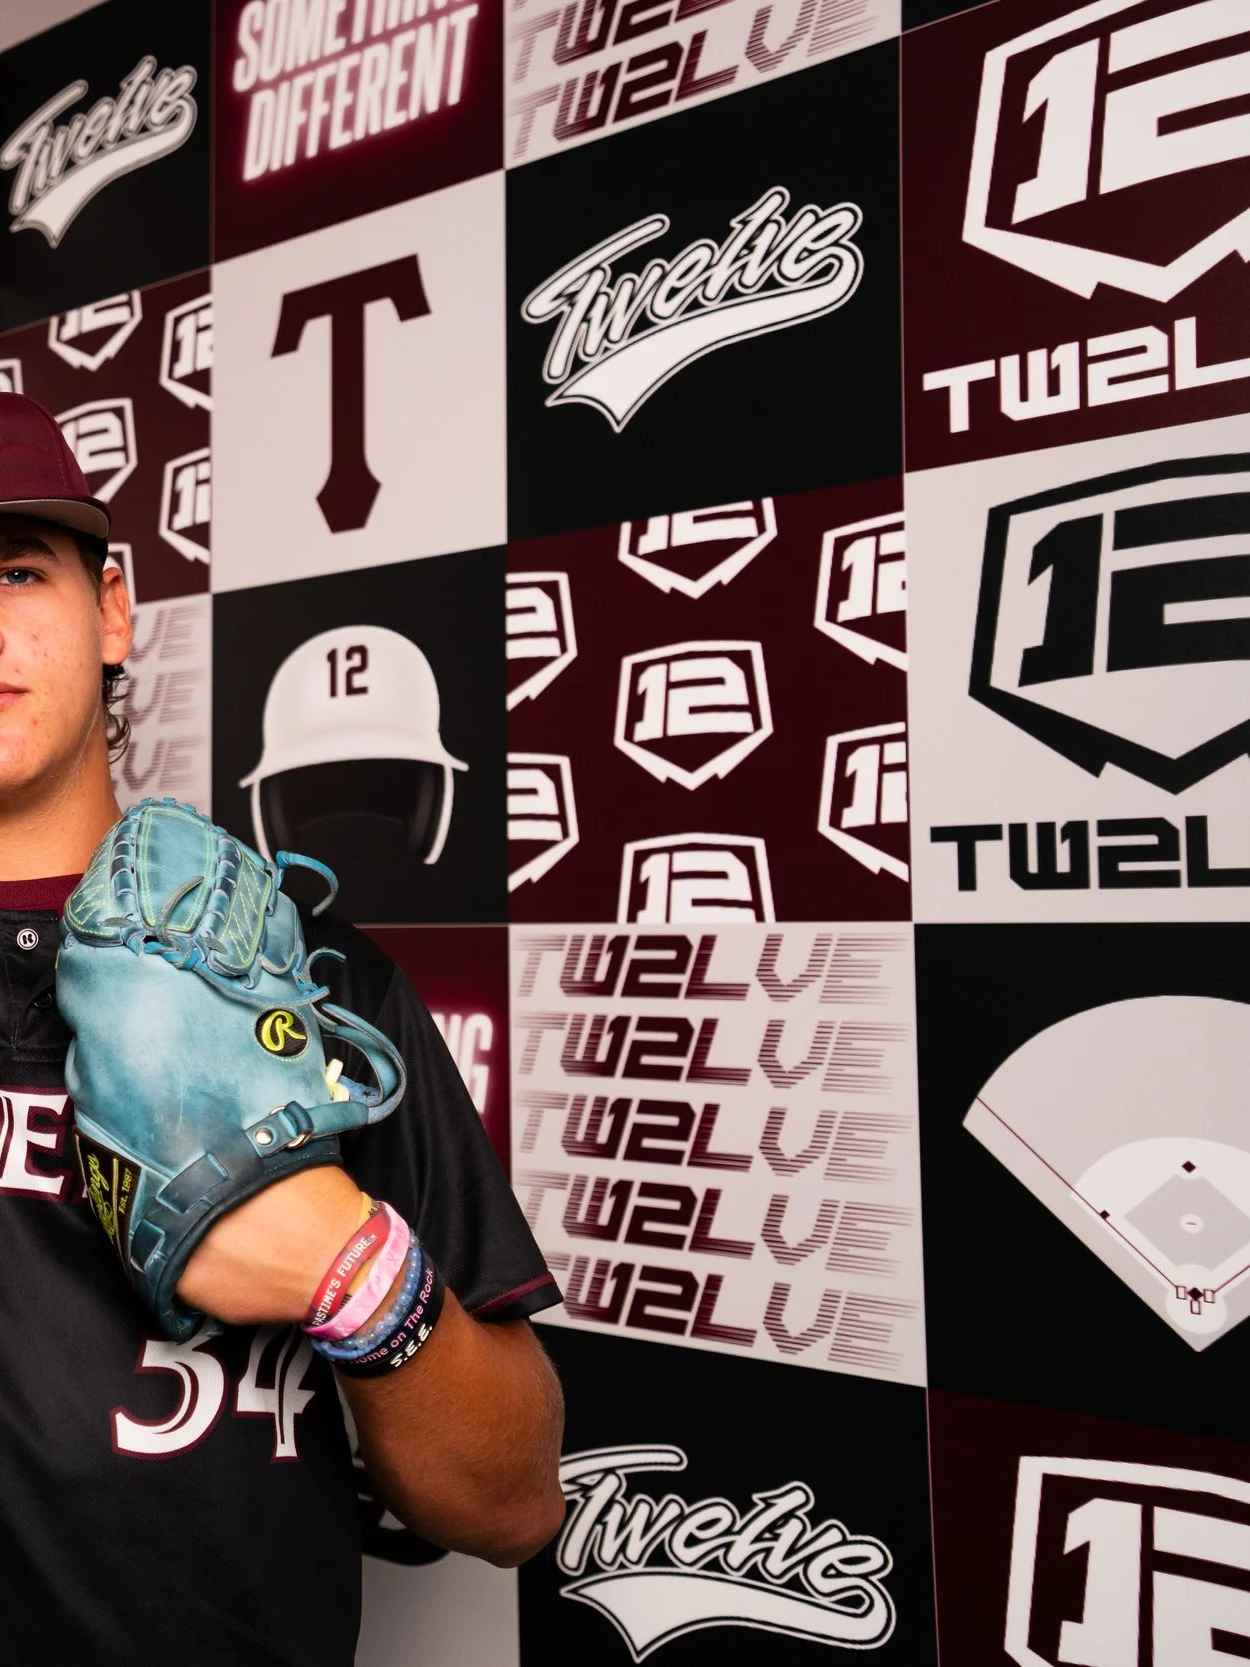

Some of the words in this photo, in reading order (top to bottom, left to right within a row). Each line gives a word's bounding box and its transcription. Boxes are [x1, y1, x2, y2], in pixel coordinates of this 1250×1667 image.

[243, 4, 479, 181] DIFFERENT
[521, 185, 863, 385] Twelve
[271, 253, 432, 534] T
[326, 644, 370, 699] 12
[633, 656, 754, 742] 12
[261, 1009, 307, 1052] R
[337, 1236, 371, 1277] FUTURE
[390, 1332, 407, 1348] on
[403, 1305, 424, 1330] The
[419, 1268, 434, 1303] Rock
[112, 1321, 316, 1461] 34
[557, 1445, 894, 1601] Twelve
